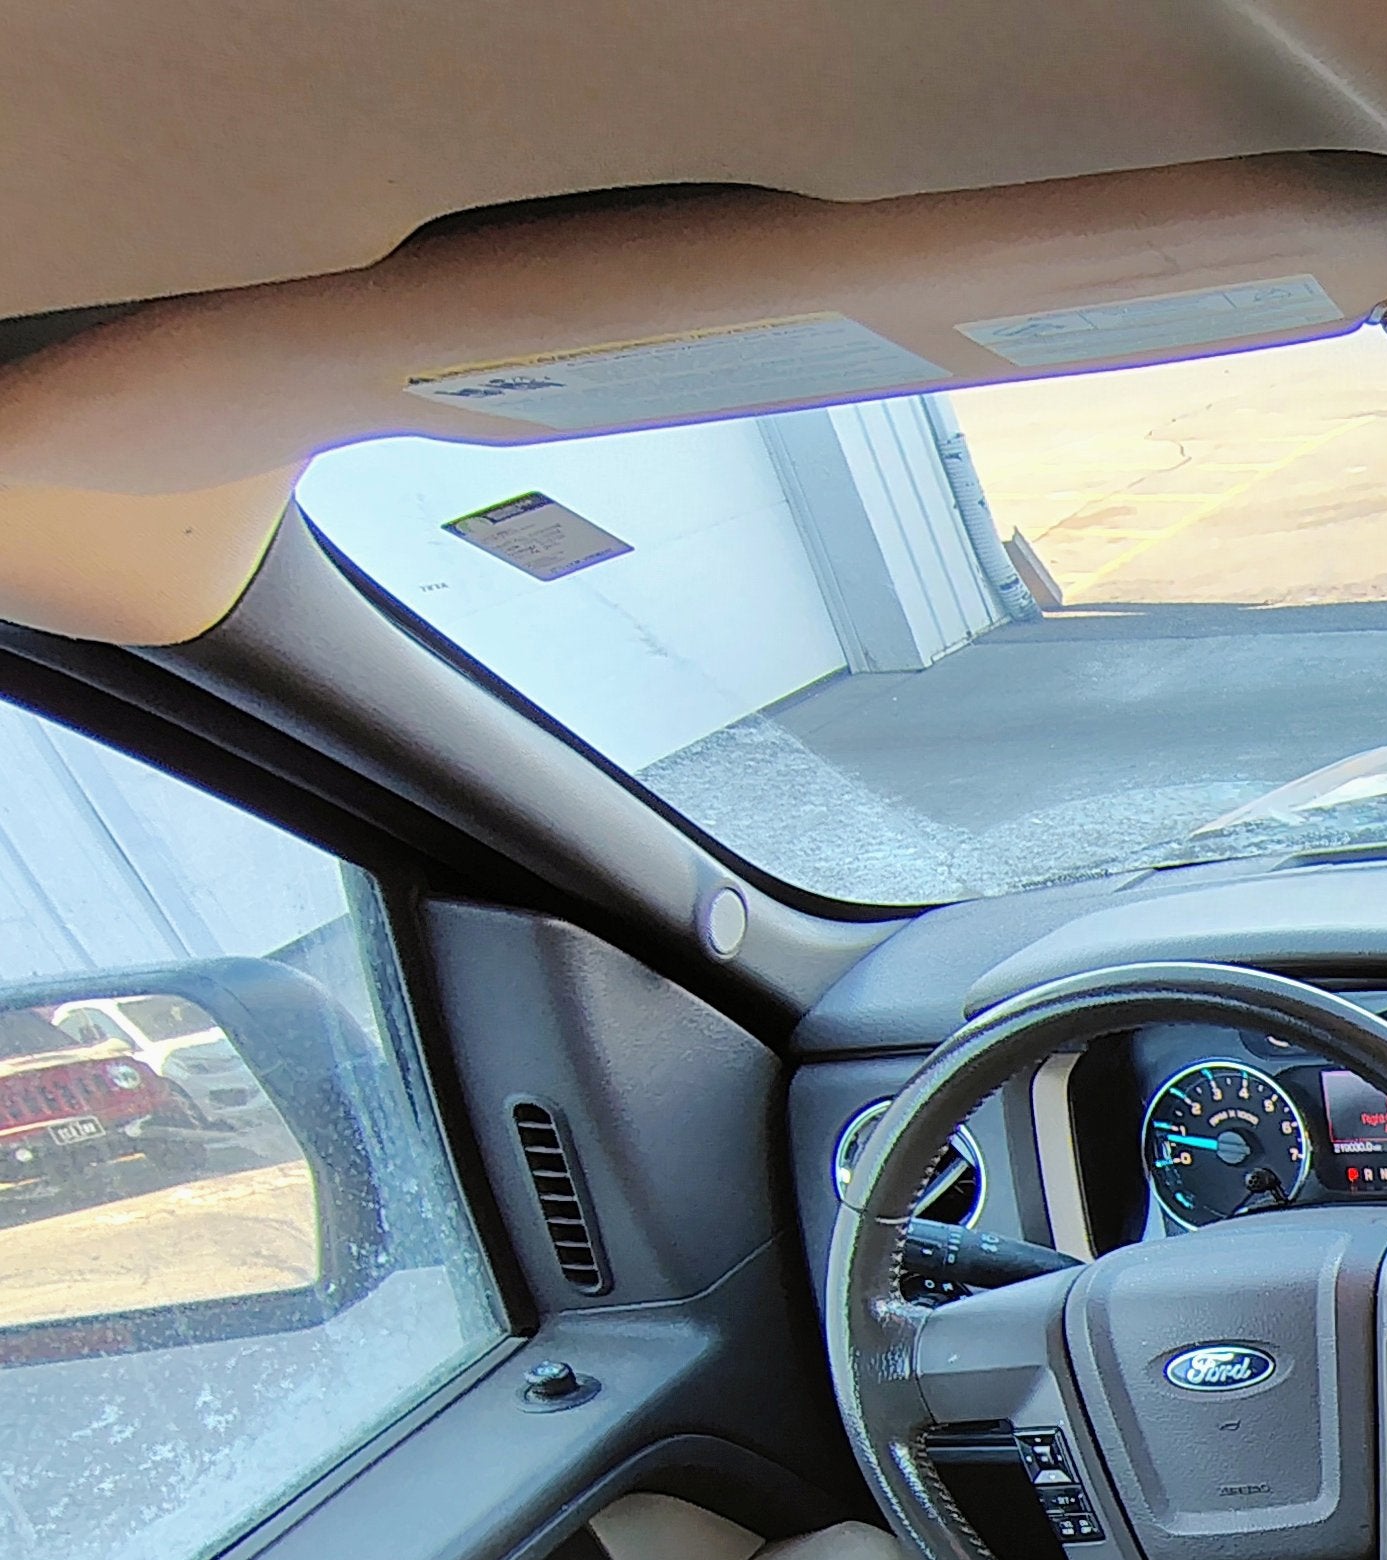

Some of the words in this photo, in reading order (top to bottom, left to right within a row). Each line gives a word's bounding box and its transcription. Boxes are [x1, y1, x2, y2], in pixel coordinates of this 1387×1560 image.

[1212, 1088, 1222, 1100] 3
[1238, 1086, 1249, 1099] 4
[1191, 1102, 1202, 1115] 2
[1263, 1099, 1275, 1112] 5
[1281, 1121, 1293, 1134] 6
[1180, 1152, 1192, 1165] 0
[1289, 1147, 1299, 1161] 7
[1363, 1167, 1373, 1181] R
[1187, 1353, 1252, 1384] Ford
